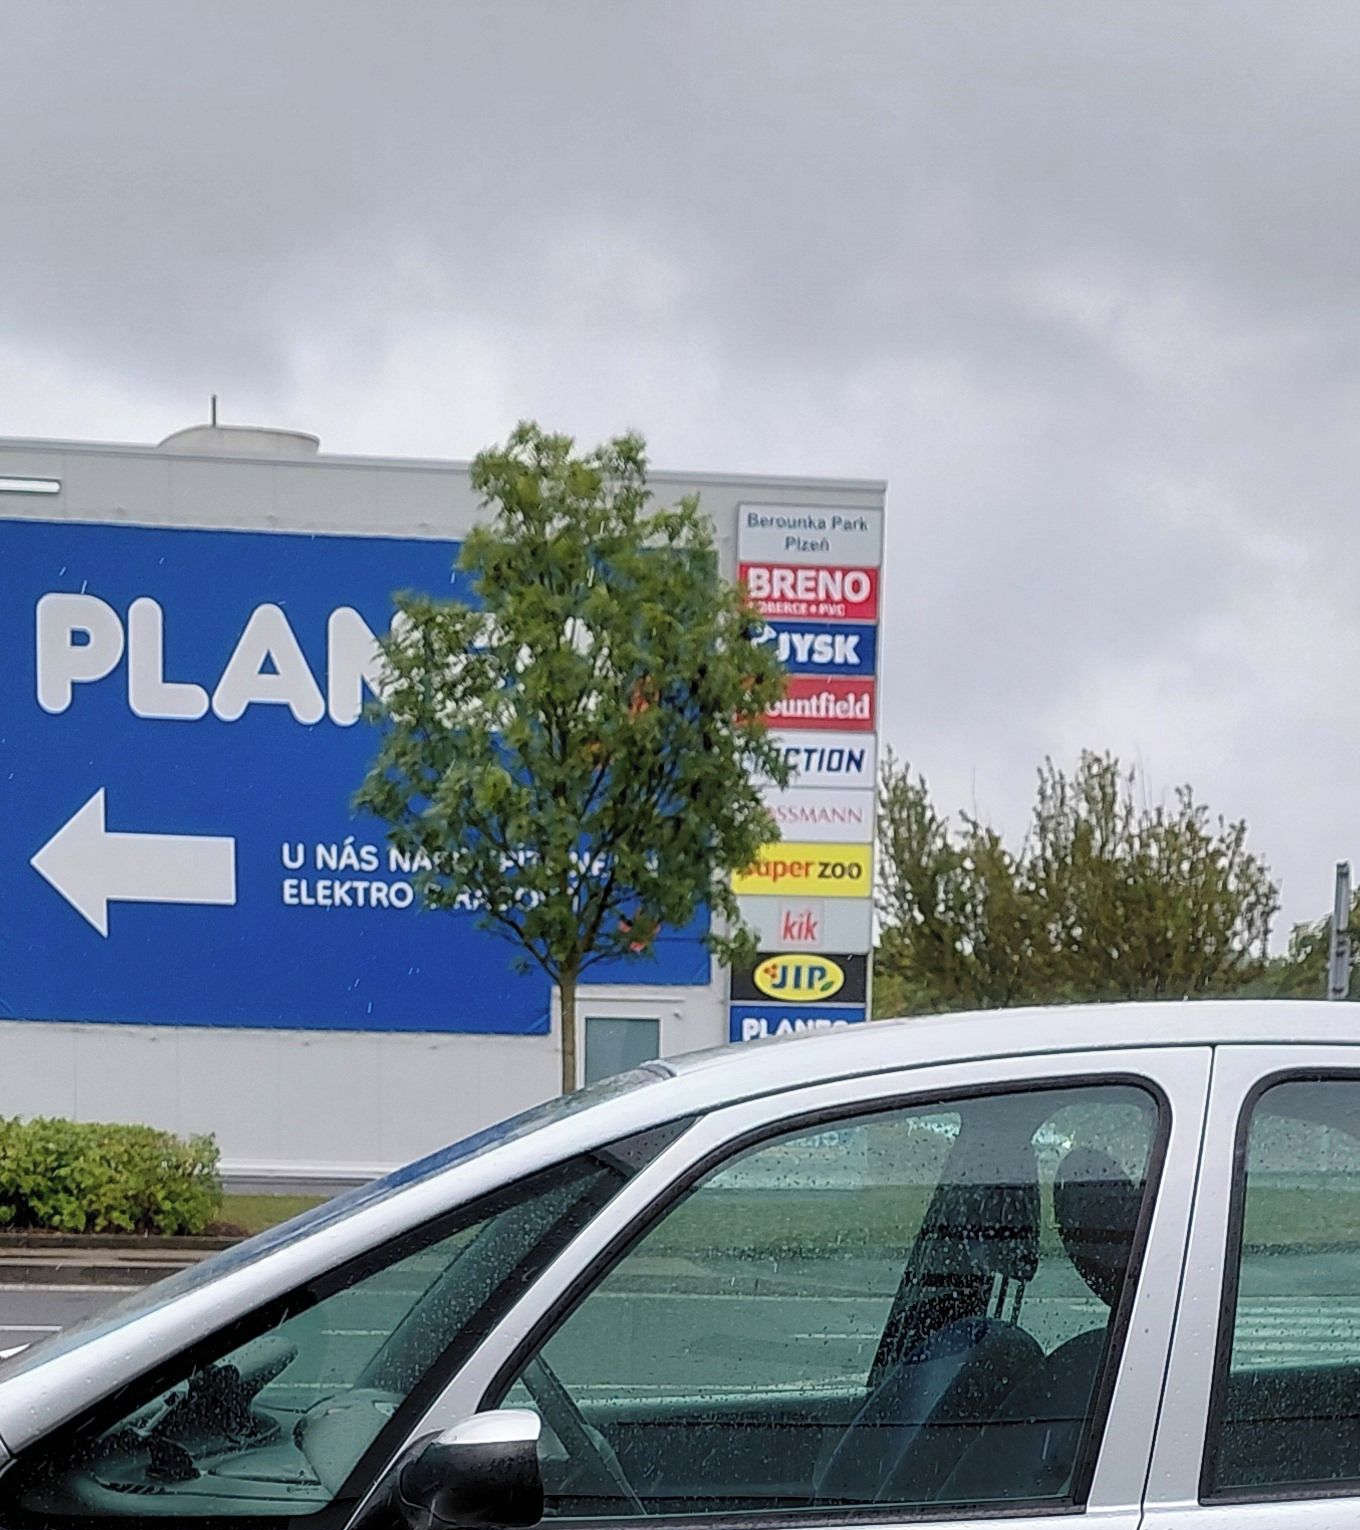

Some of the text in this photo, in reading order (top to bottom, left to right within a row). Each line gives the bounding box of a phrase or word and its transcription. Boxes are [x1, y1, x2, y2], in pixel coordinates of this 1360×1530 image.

[747, 512, 868, 531] Berounka Park
[785, 536, 830, 552] Plzeň
[748, 567, 871, 602] BRENO
[747, 601, 846, 616] OBERCE PVC
[776, 632, 861, 664] JYSK
[764, 692, 870, 719] ountfield
[777, 747, 866, 773] CTION
[769, 805, 864, 824] SSMANN
[281, 842, 305, 870] U
[315, 836, 380, 871] NÁS
[818, 862, 863, 880] zoo
[282, 878, 415, 908] ELEKTRO
[782, 910, 820, 941] kik
[771, 964, 827, 990] JIP
